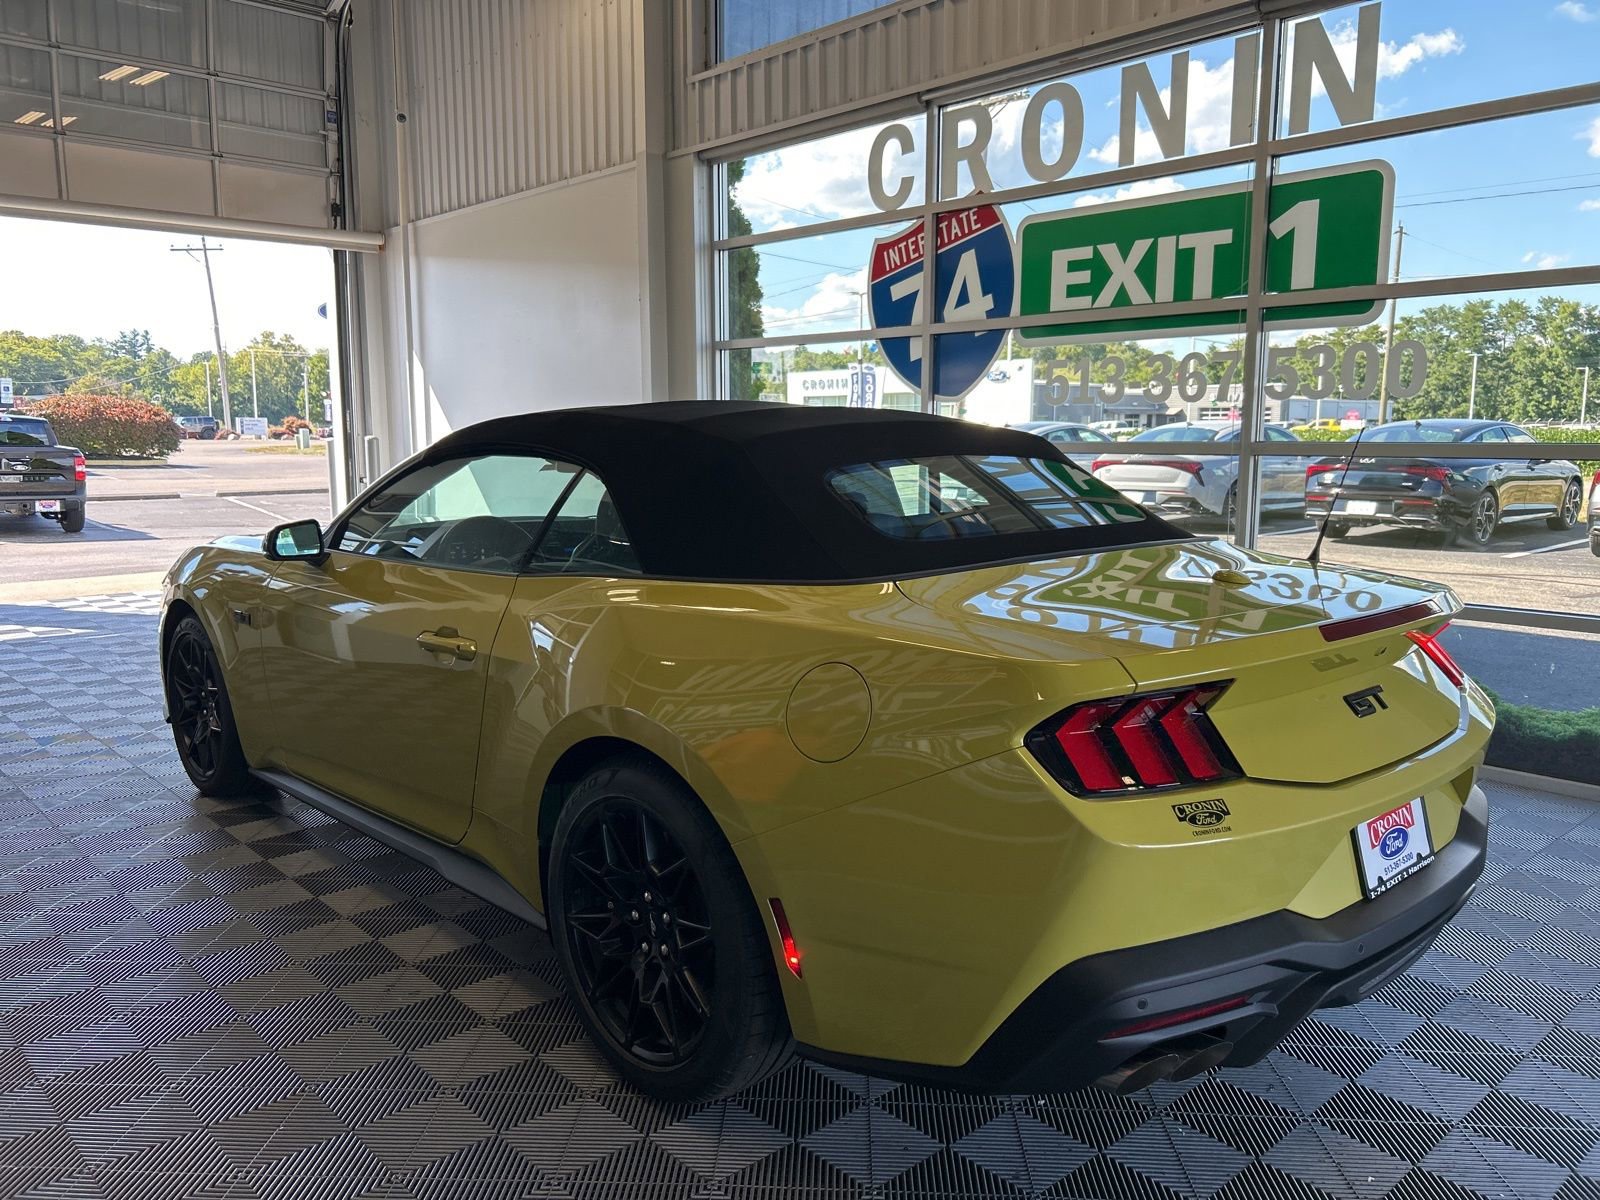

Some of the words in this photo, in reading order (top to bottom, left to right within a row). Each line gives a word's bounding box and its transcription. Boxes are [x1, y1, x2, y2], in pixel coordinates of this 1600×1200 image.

[868, 4, 1382, 212] CRONIN
[884, 208, 981, 272] INTERTATE
[1050, 229, 1233, 312] EXIT
[1269, 200, 1321, 290] 1
[889, 249, 995, 362] 74
[802, 378, 848, 391] CRONIN
[1343, 684, 1389, 718] GT
[1174, 799, 1229, 818] CRONIN
[1195, 813, 1217, 825] Ford
[1371, 804, 1413, 846] CRONIN
[1385, 832, 1404, 854] Ford
[1370, 885, 1386, 899] I-74
[1386, 874, 1402, 889] EXIT
[1408, 855, 1435, 875] Harrison
